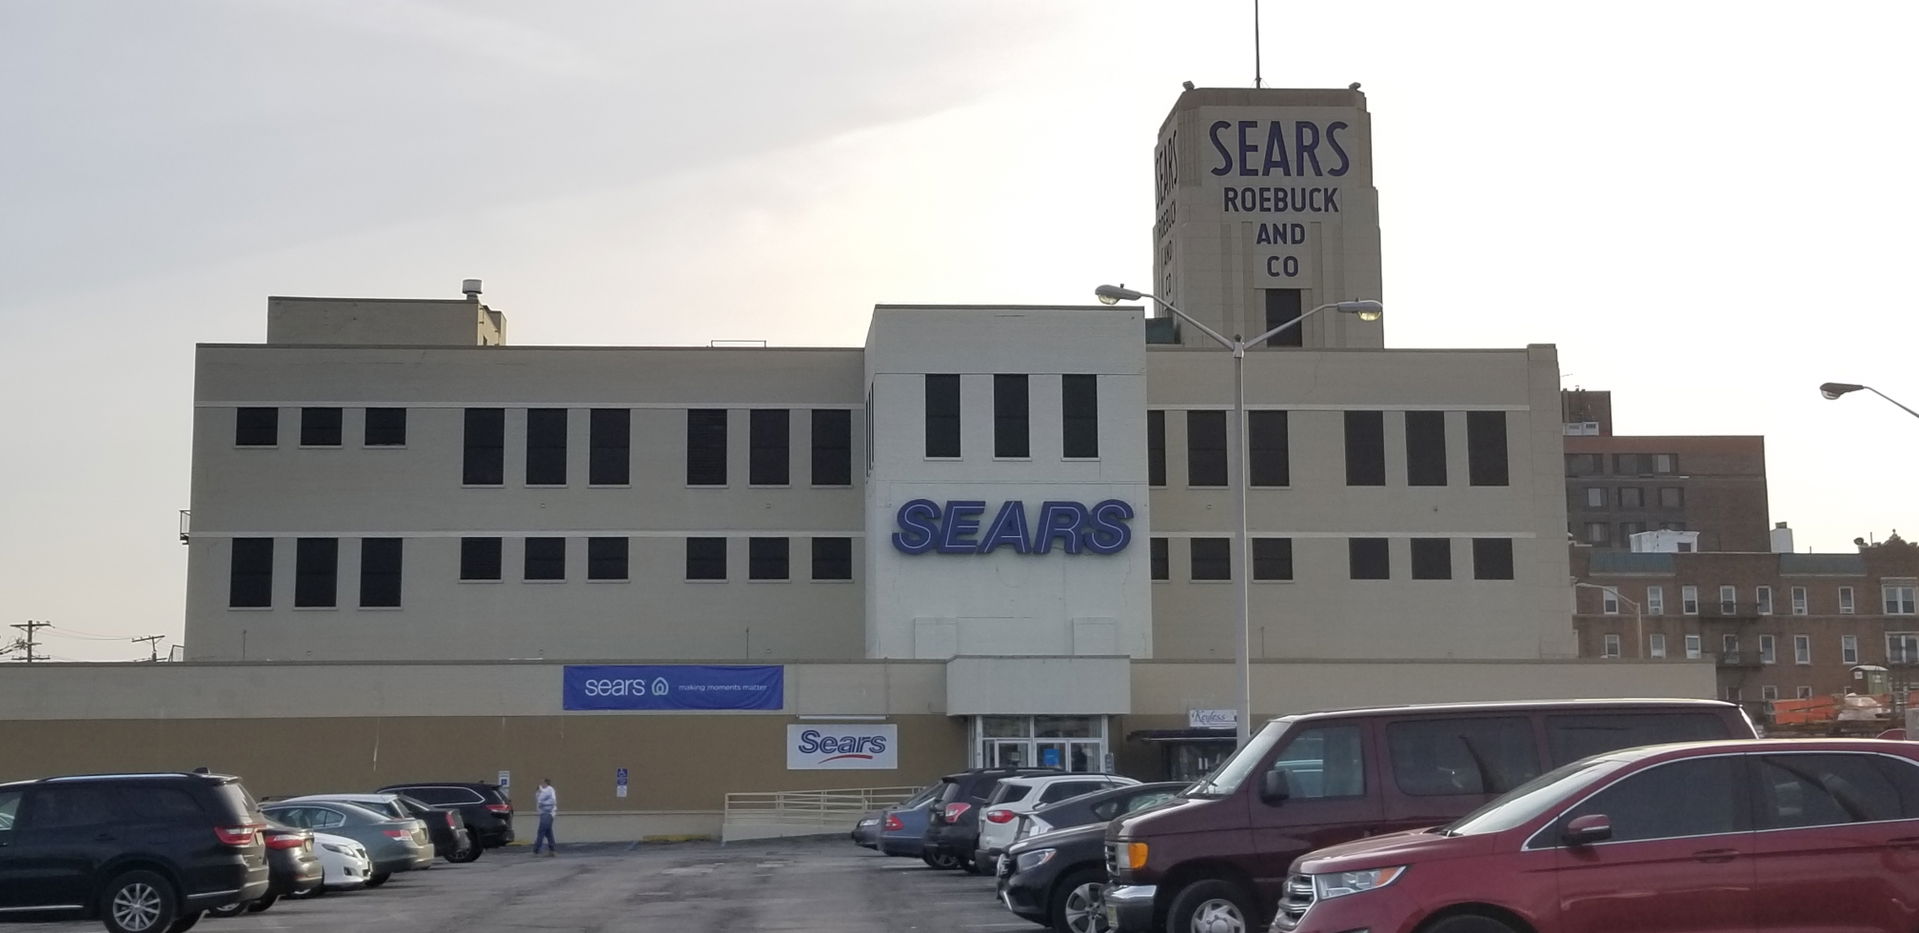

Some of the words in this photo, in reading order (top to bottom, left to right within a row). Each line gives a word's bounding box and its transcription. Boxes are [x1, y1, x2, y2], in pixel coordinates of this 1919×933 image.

[1209, 120, 1350, 177] SEARS
[1155, 129, 1178, 211] SEARS
[1224, 187, 1339, 213] ROEBUCK
[1256, 223, 1306, 245] AND
[1267, 255, 1299, 277] CO
[892, 499, 1134, 555] SEARS
[585, 679, 646, 696] sears
[678, 683, 706, 692] making
[798, 729, 887, 754] Sears
